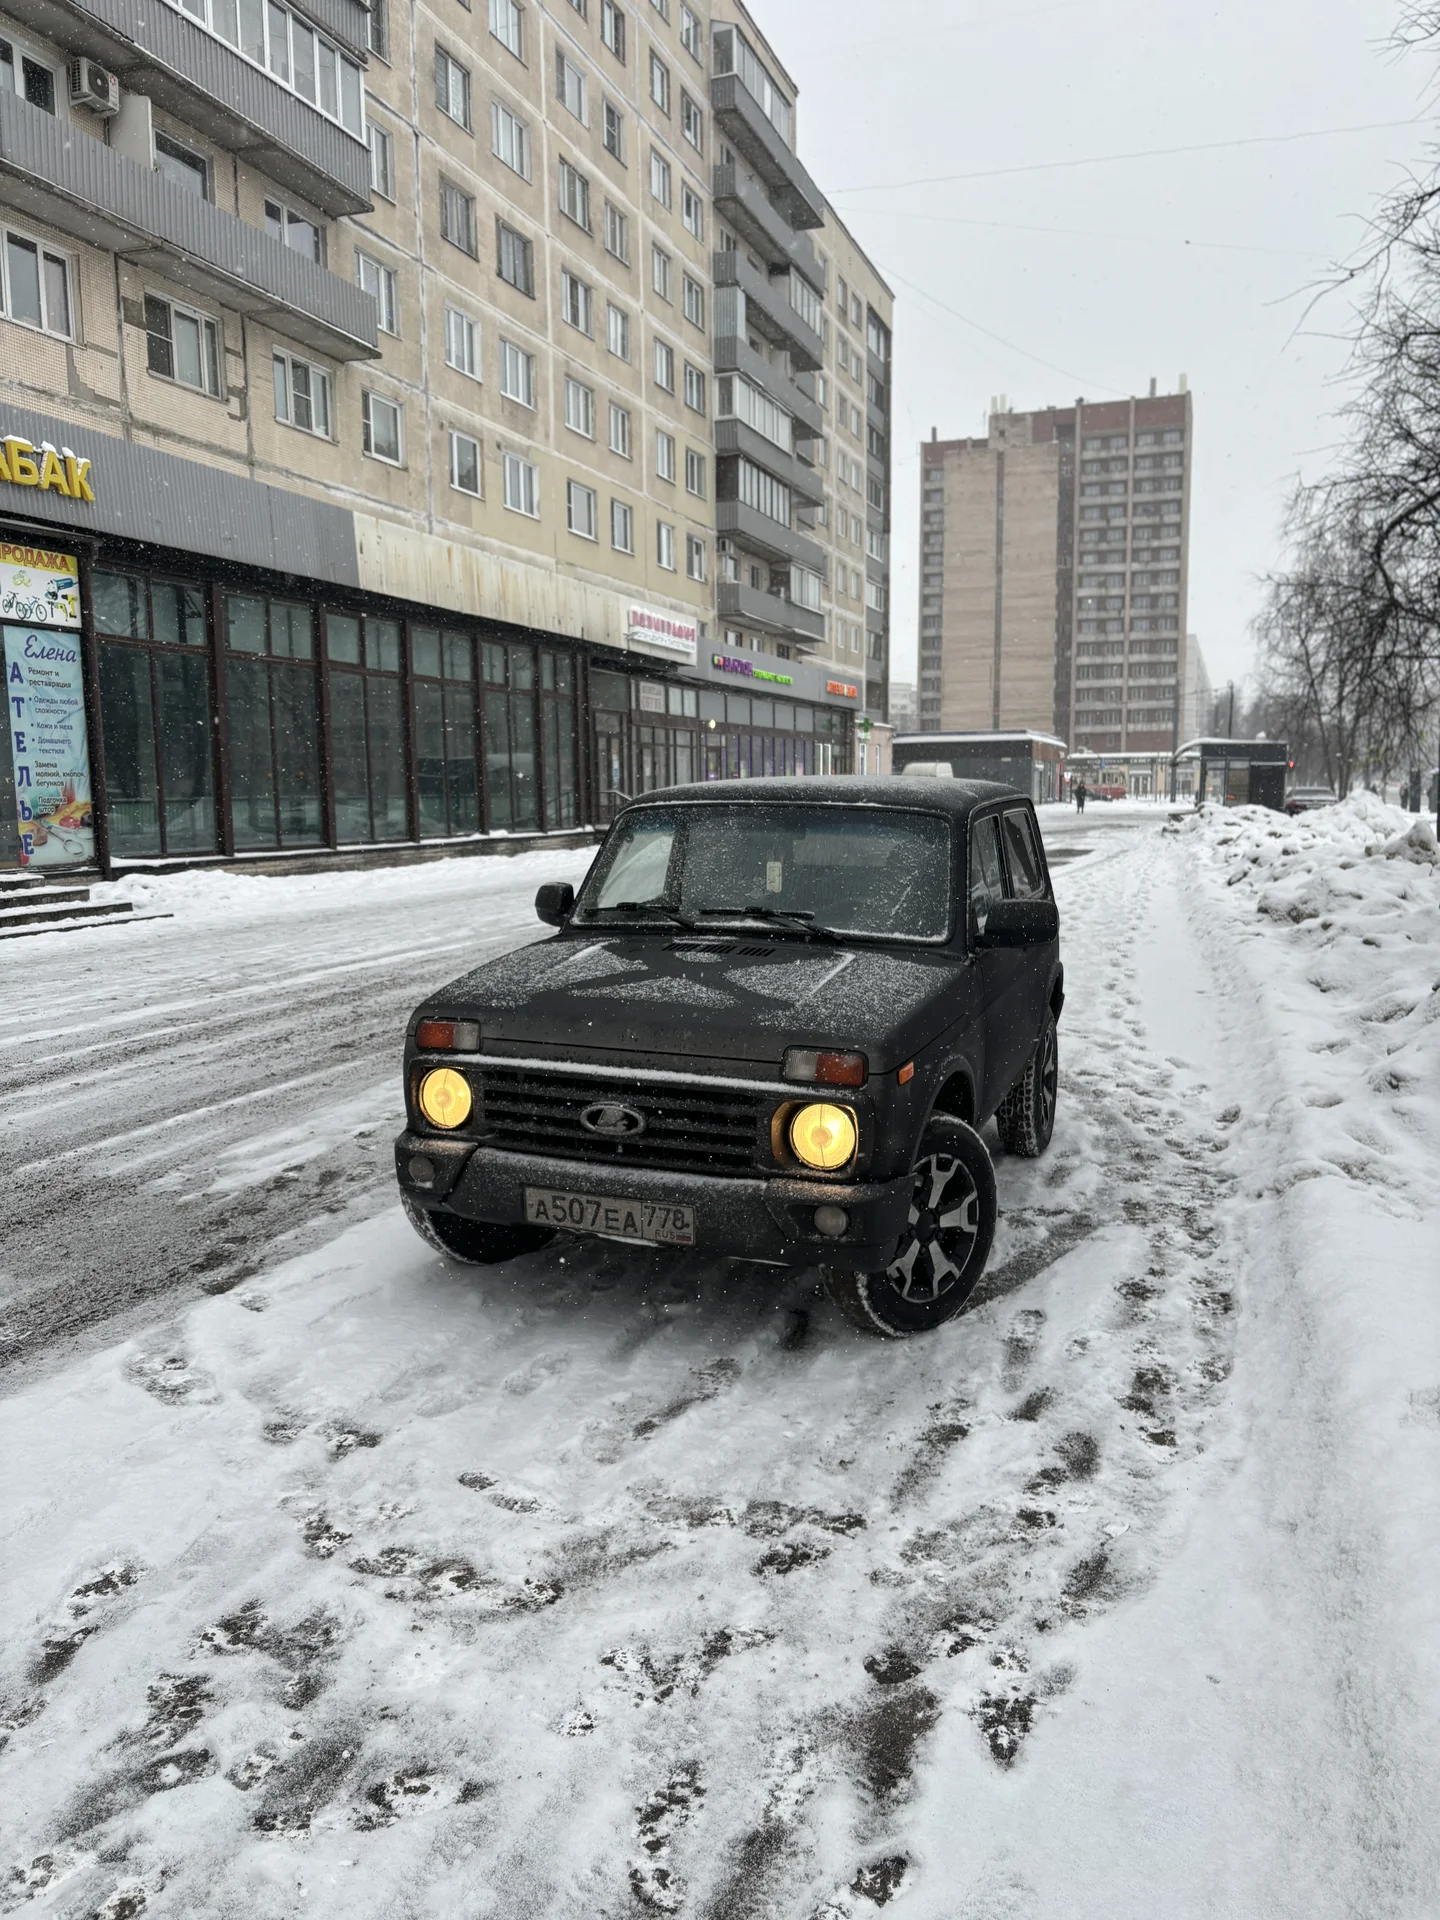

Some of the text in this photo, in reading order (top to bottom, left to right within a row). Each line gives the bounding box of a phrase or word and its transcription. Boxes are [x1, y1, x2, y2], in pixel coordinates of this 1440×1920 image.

[0, 543, 71, 572] РОДАЖА
[24, 634, 77, 663] Елена
[28, 666, 53, 676] Ремонт
[29, 679, 72, 689] реставрация
[34, 695, 79, 706] Одежды любой
[35, 707, 67, 715] сложности
[36, 722, 53, 730] Кожи
[37, 736, 72, 745] Домашнего
[34, 760, 58, 769] Замена
[36, 780, 65, 788] бегунков
[38, 796, 67, 805] Подгонка
[39, 807, 55, 815] штор
[535, 1194, 639, 1234] А507ЕА
[655, 1229, 676, 1240] RUS
